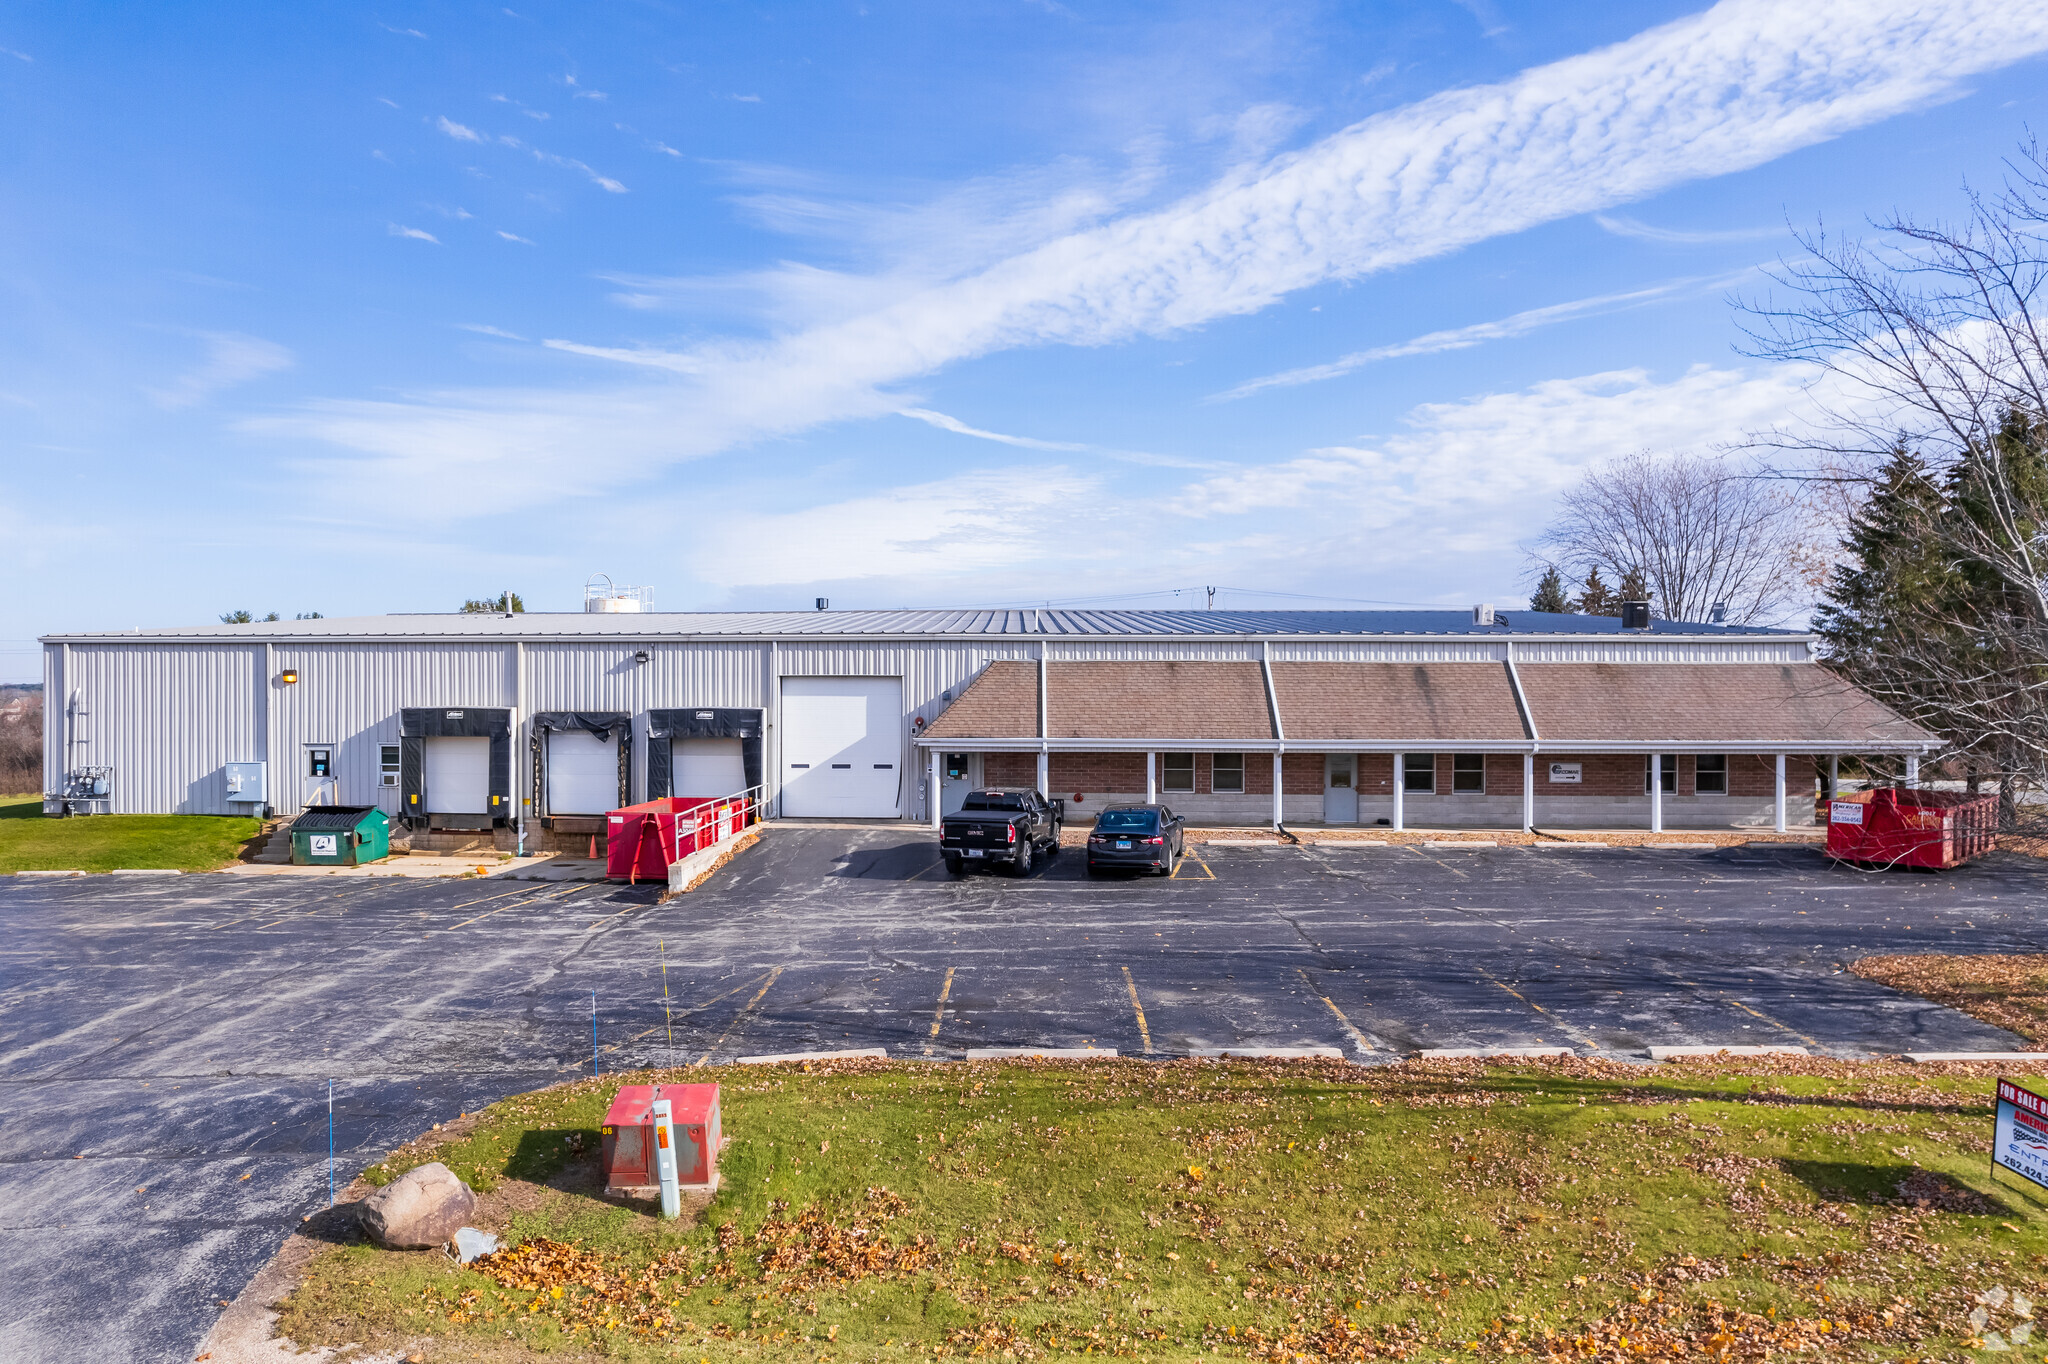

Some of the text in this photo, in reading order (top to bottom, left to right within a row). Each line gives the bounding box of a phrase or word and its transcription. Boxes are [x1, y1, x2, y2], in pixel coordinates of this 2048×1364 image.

[2000, 1083, 2048, 1116] FOR SALE O
[602, 1126, 612, 1135] 06
